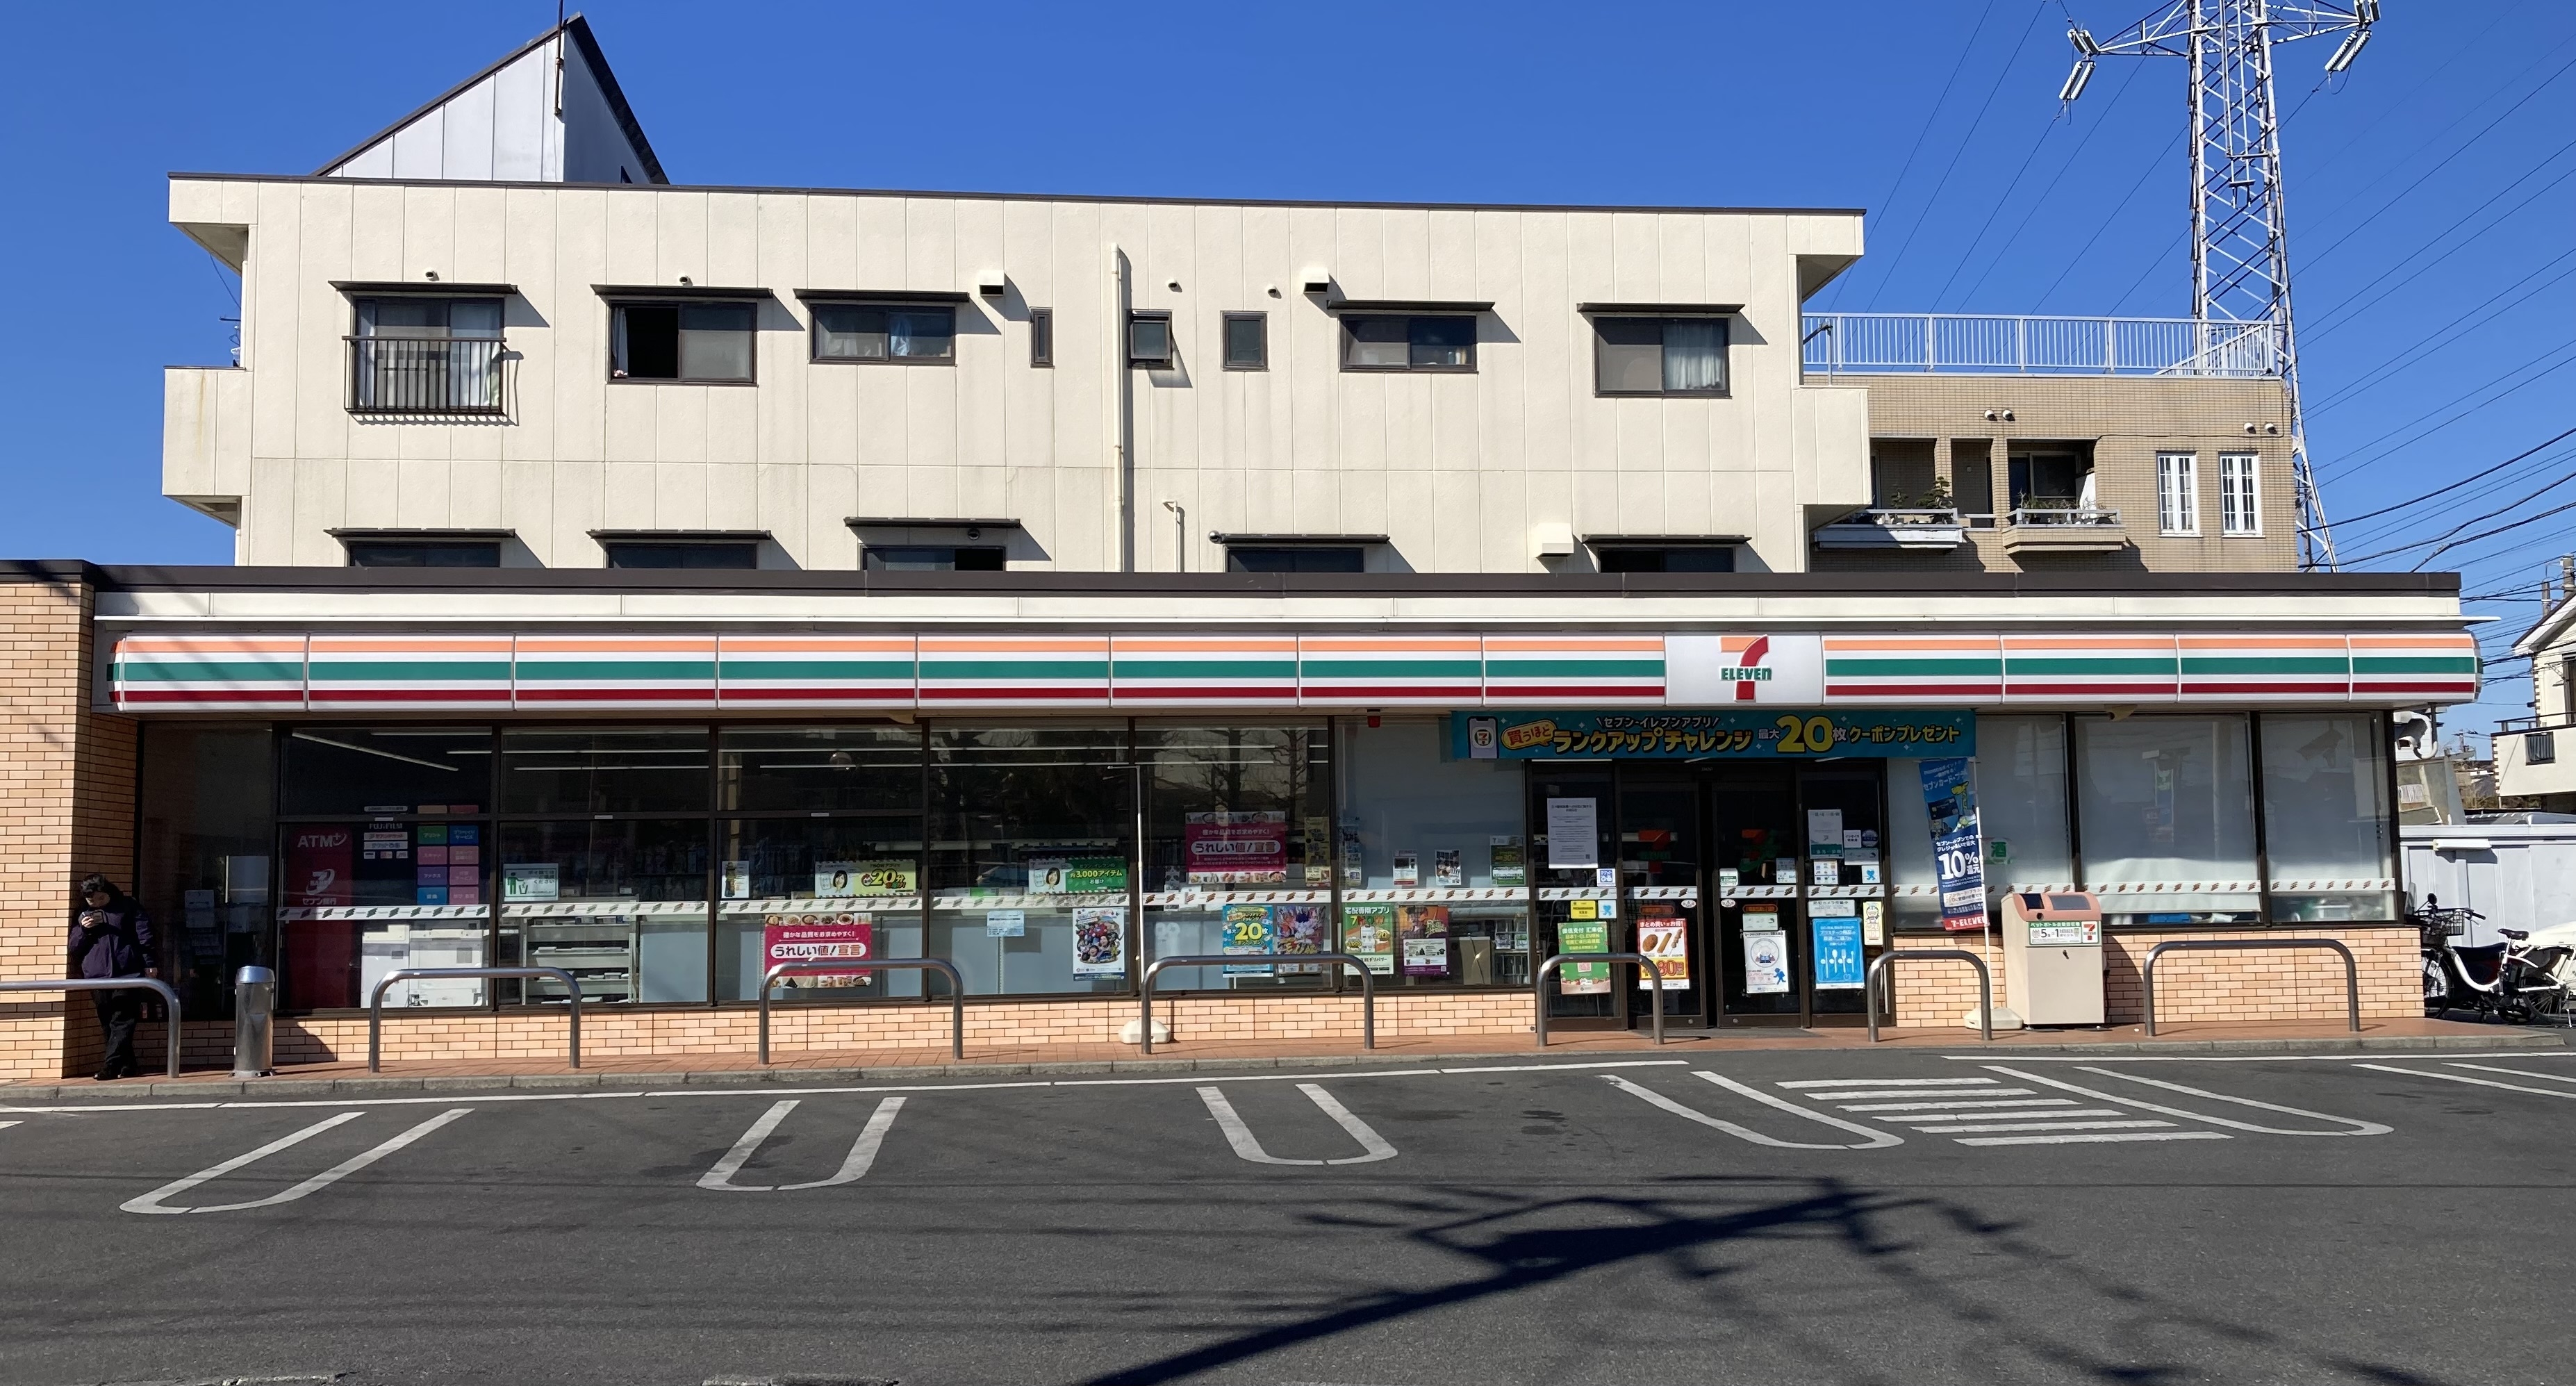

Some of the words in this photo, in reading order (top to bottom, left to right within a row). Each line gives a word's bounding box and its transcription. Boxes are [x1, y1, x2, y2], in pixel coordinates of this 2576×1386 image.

[1720, 635, 1769, 701] 7
[1508, 725, 1552, 745] 買うほど
[1991, 841, 2006, 857] 酒
